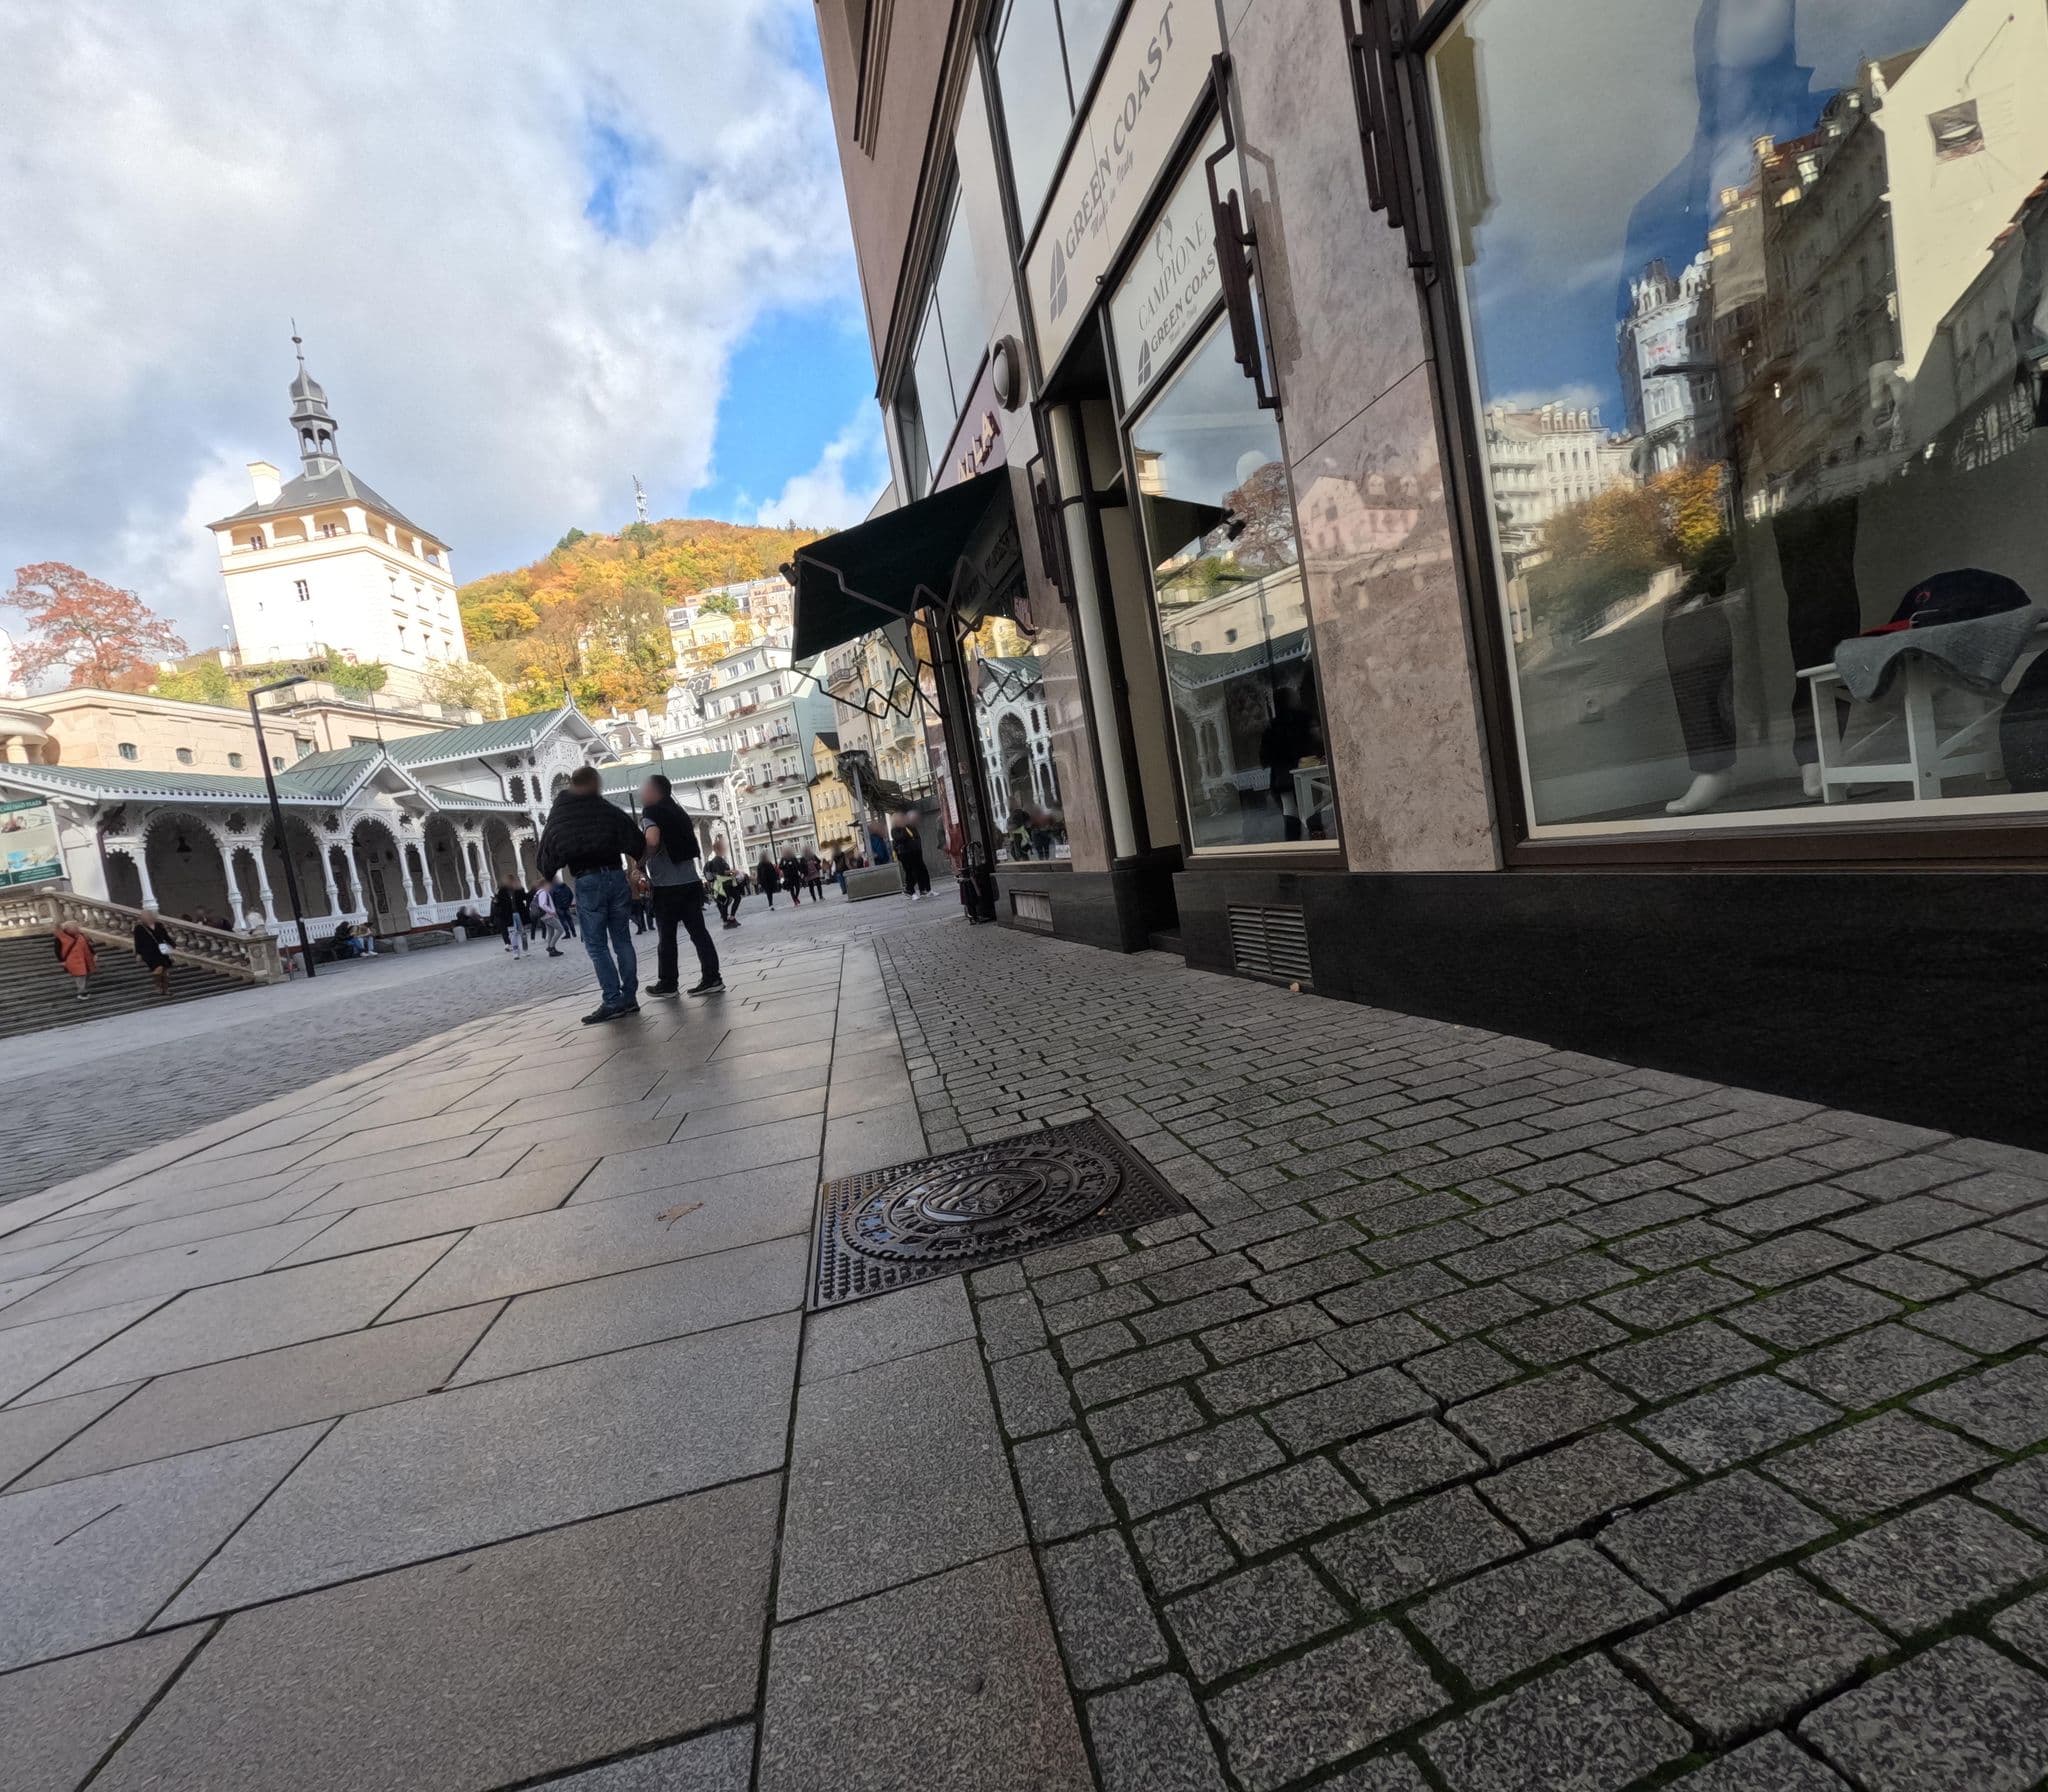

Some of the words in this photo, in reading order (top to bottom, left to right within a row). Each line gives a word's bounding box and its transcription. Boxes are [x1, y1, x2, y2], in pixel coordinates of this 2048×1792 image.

[1065, 145, 1111, 259] GREEN
[1113, 1, 1174, 156] COAST
[1138, 214, 1207, 332] CAMPIONE
[1151, 297, 1183, 353] GREEN
[1184, 253, 1216, 305] COAS
